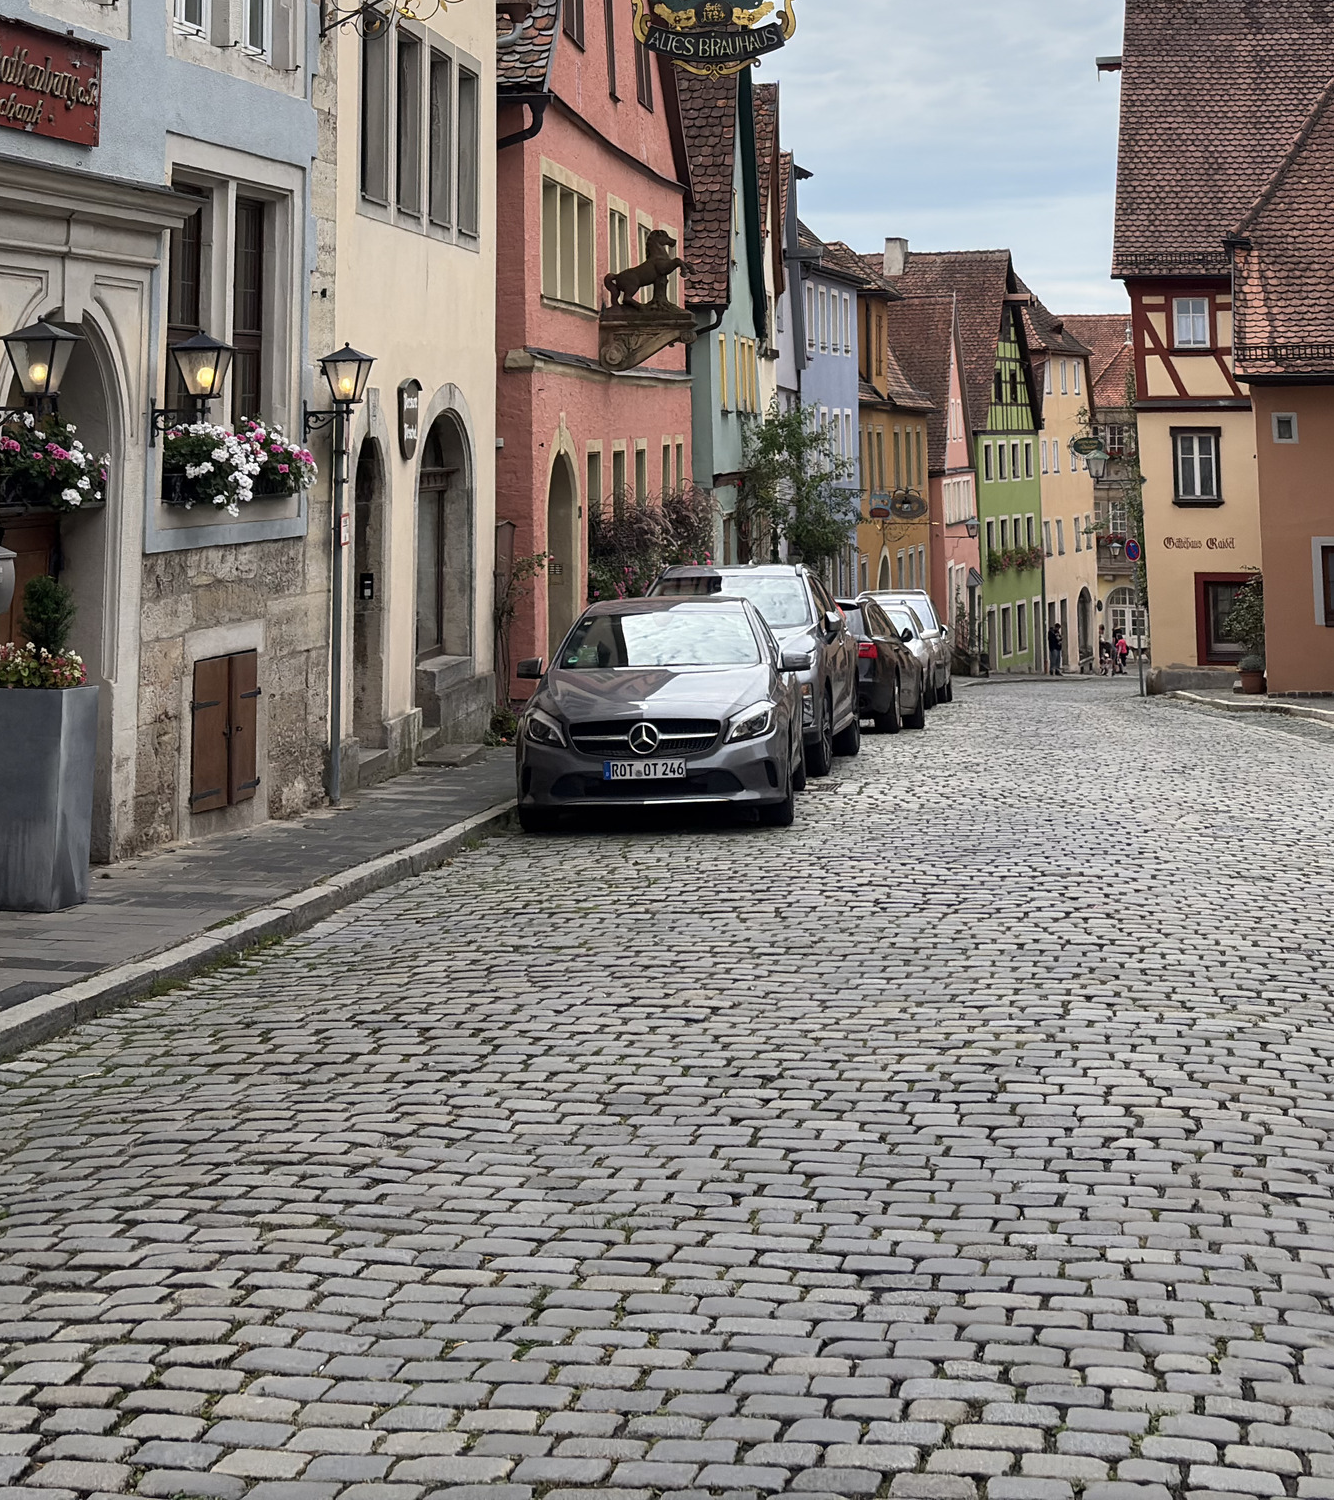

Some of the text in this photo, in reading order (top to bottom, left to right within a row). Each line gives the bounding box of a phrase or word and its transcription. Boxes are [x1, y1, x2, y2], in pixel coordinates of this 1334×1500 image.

[701, 10, 726, 23] 1724
[648, 28, 778, 57] ALTES BRAUHAUS
[611, 763, 634, 777] ROT
[643, 762, 659, 776] OT
[661, 762, 684, 776] 246
